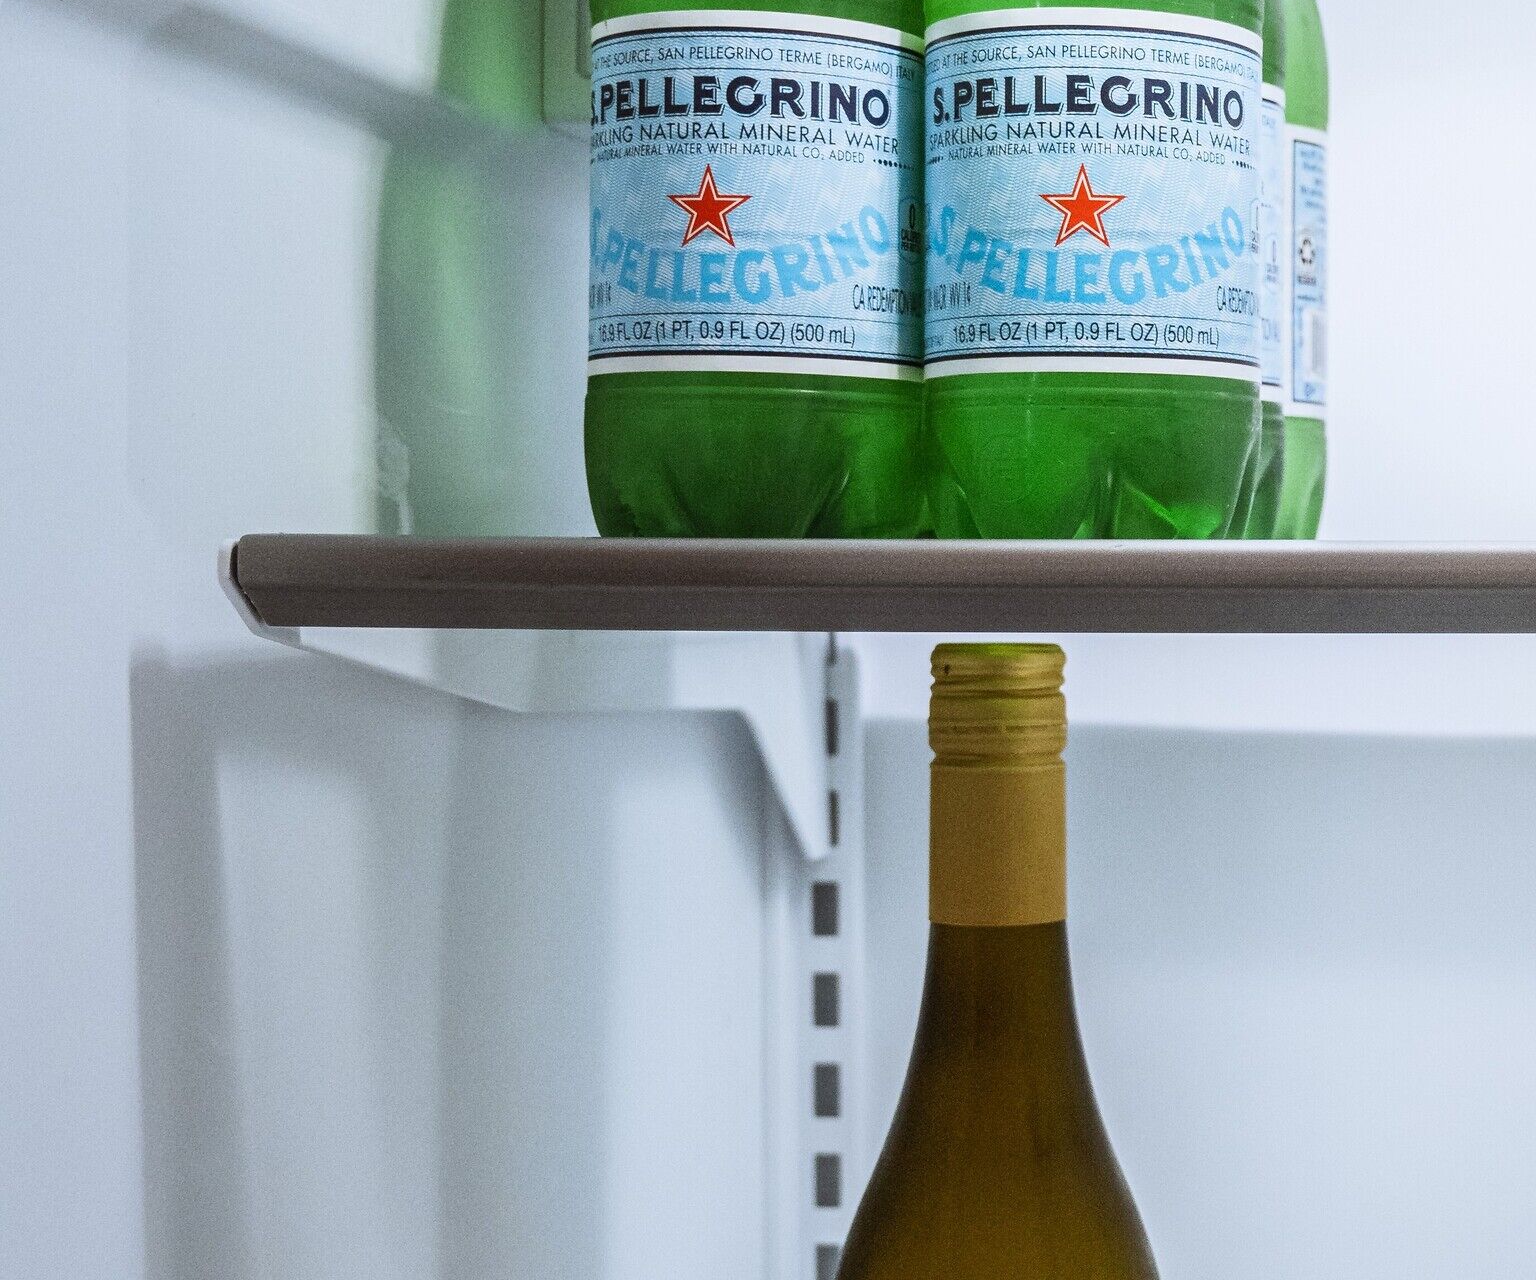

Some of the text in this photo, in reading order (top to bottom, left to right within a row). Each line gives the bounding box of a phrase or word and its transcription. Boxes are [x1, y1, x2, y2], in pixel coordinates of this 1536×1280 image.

[613, 48, 655, 67] SOURCE,
[658, 46, 685, 61] SAN
[689, 46, 774, 62] PELLEGRINO
[778, 49, 821, 66] TERME
[971, 46, 1022, 63] SOURCE,
[1026, 45, 1056, 59] SAN
[1061, 45, 1146, 61] PELLEGRINO
[1151, 48, 1190, 65] TERME
[934, 75, 1245, 131] S.PELLEGRINO
[640, 122, 899, 156] NATURAL MINERAL WATER
[929, 122, 1250, 156] SPARKLING NATURAL MINERAL WATER
[633, 321, 652, 341] OZ
[700, 321, 724, 340] 0.9
[730, 322, 746, 340] FL
[755, 321, 785, 344] OZ)
[790, 322, 824, 344] (500
[829, 324, 856, 348] mL)
[952, 322, 1220, 349] 16.9 FL OZ (1 PT, 0.9 FL OZ) (500 mL)
